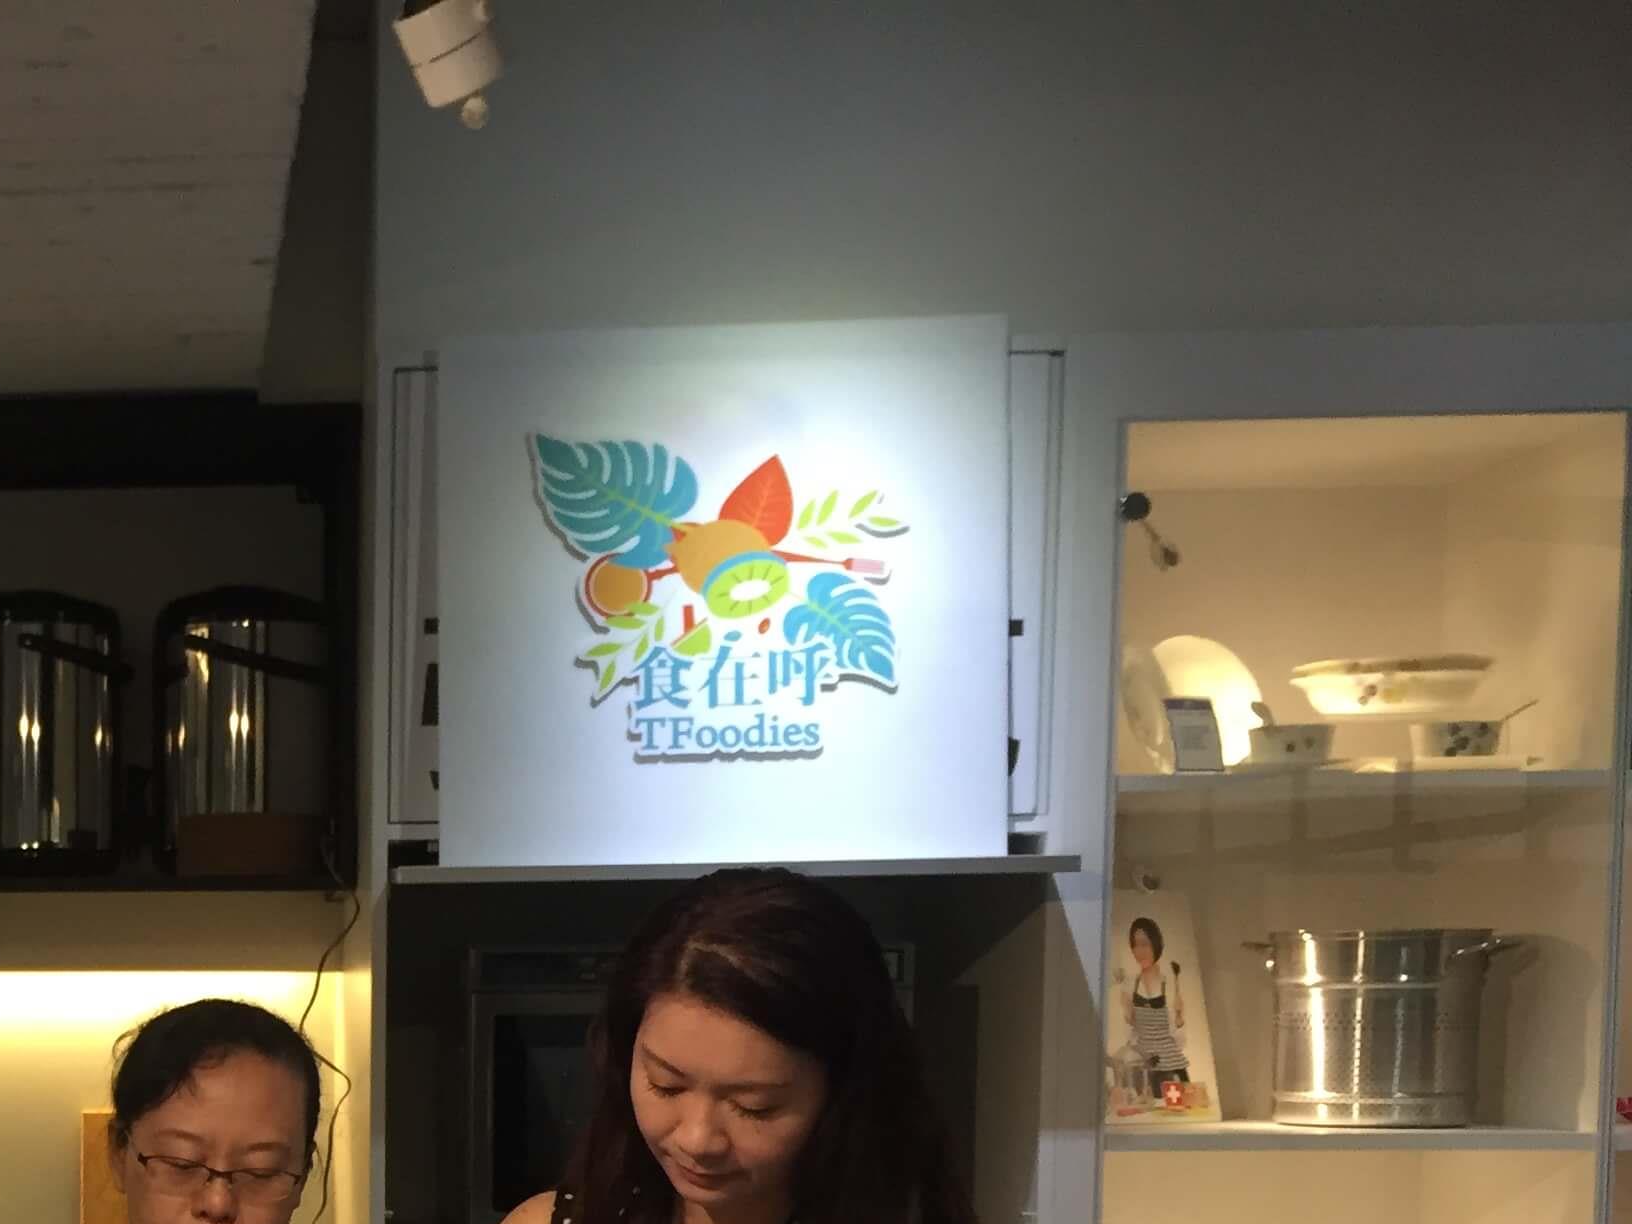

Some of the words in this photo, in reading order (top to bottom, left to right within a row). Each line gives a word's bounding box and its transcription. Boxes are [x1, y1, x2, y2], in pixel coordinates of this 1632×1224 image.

[633, 641, 838, 710] 食在呼
[635, 714, 821, 751] TFoodies
